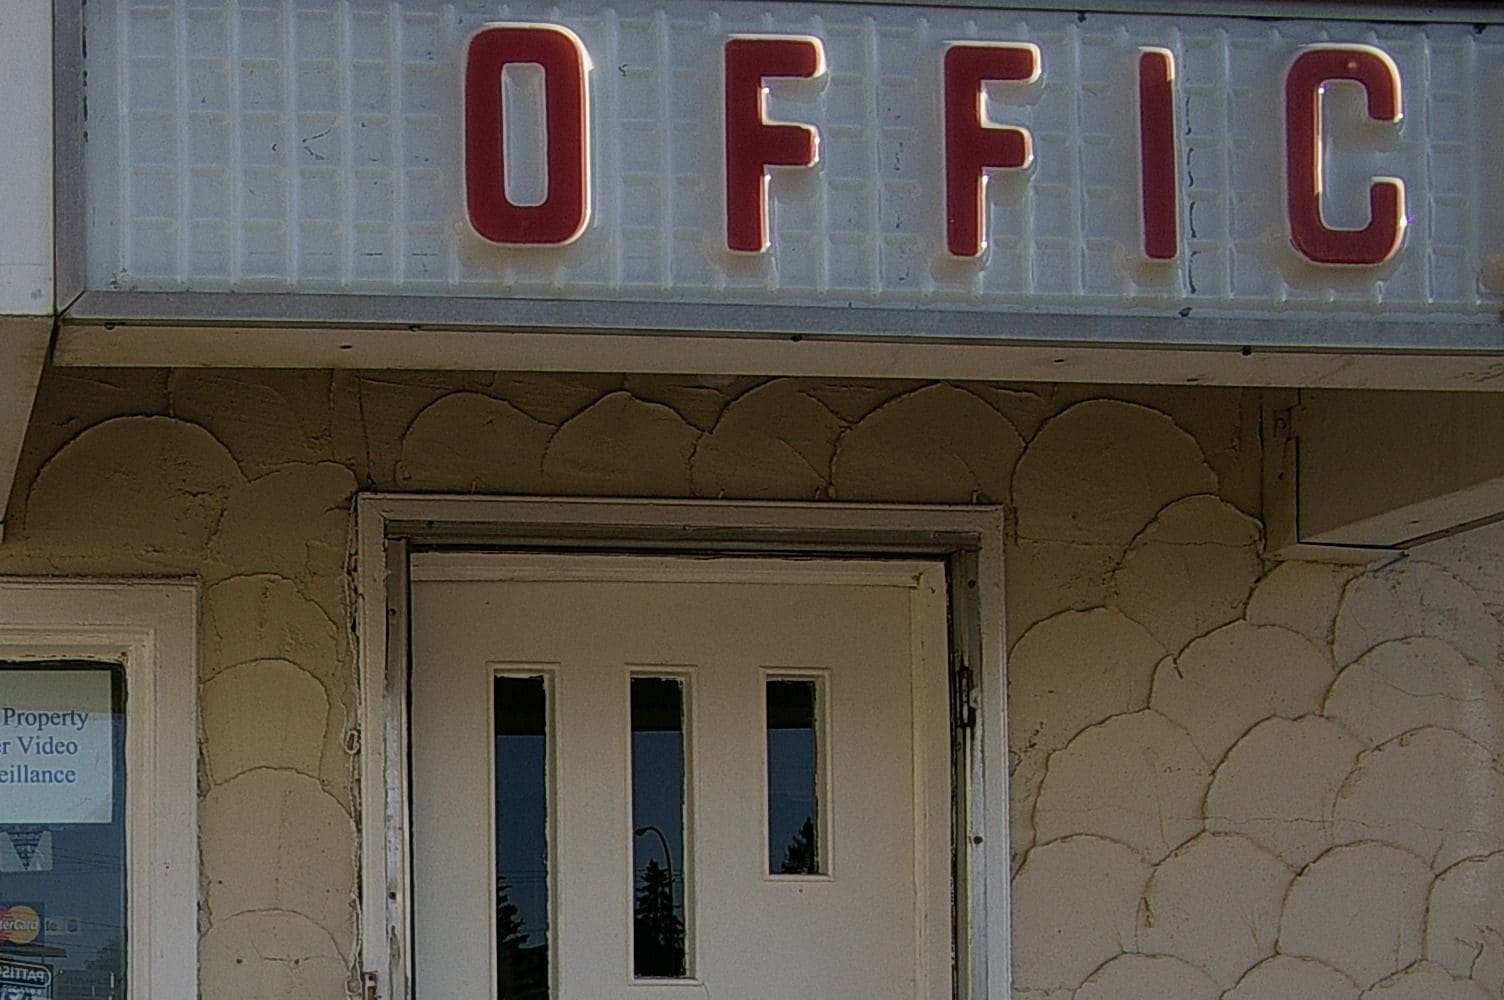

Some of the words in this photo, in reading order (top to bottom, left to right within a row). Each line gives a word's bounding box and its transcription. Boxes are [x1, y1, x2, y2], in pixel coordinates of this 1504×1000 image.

[463, 21, 1408, 267] OFFIC
[2, 707, 89, 731] Property
[17, 736, 79, 755] Video
